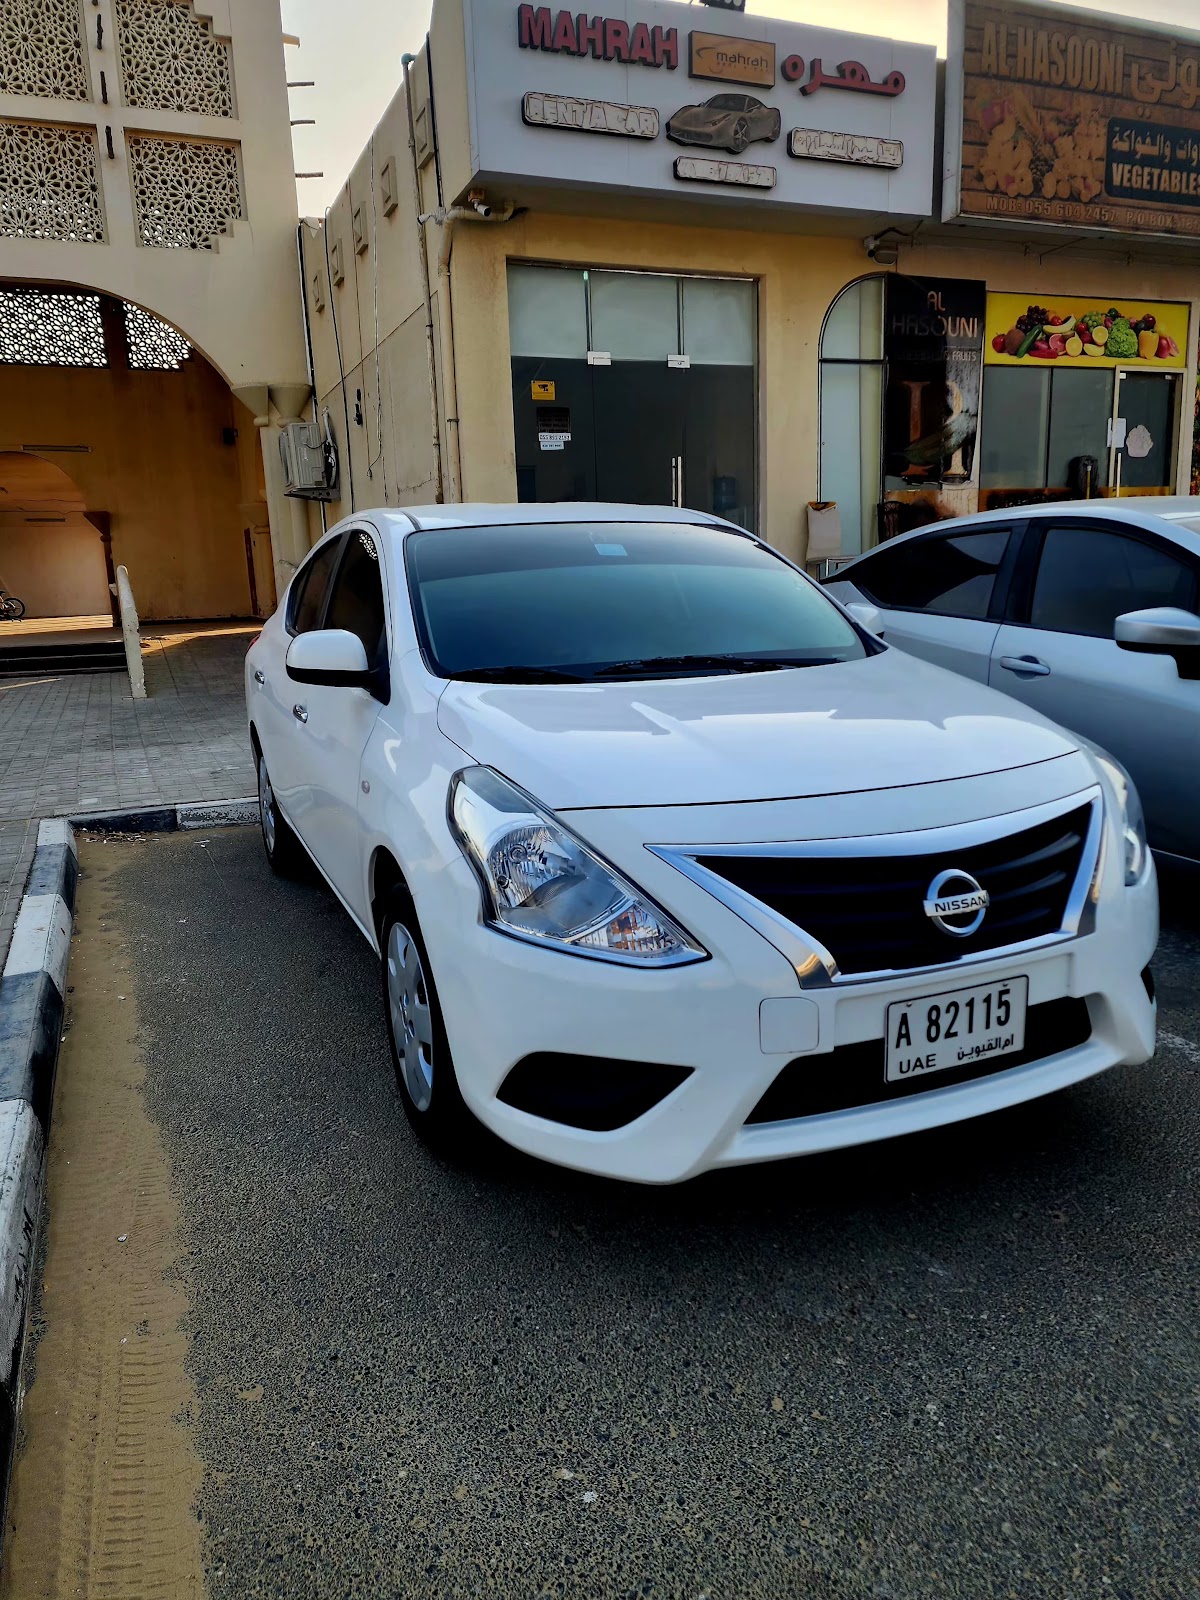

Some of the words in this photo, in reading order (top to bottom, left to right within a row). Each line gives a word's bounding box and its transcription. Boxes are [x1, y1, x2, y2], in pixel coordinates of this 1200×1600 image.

[518, 4, 678, 70] MAHRAH
[716, 51, 769, 69] mahrah
[981, 19, 1009, 77] AL
[1016, 26, 1125, 95] HASOONI
[986, 195, 1022, 213] MOB:
[1025, 202, 1051, 216] 055
[1055, 204, 1081, 219] 604
[927, 290, 946, 312] AL
[892, 315, 978, 338] HASOUNI
[952, 351, 977, 362] FRUITS
[934, 895, 987, 913] NISSAN
[895, 1012, 912, 1049] A
[926, 988, 1011, 1044] 82115
[899, 1053, 937, 1074] UAE
